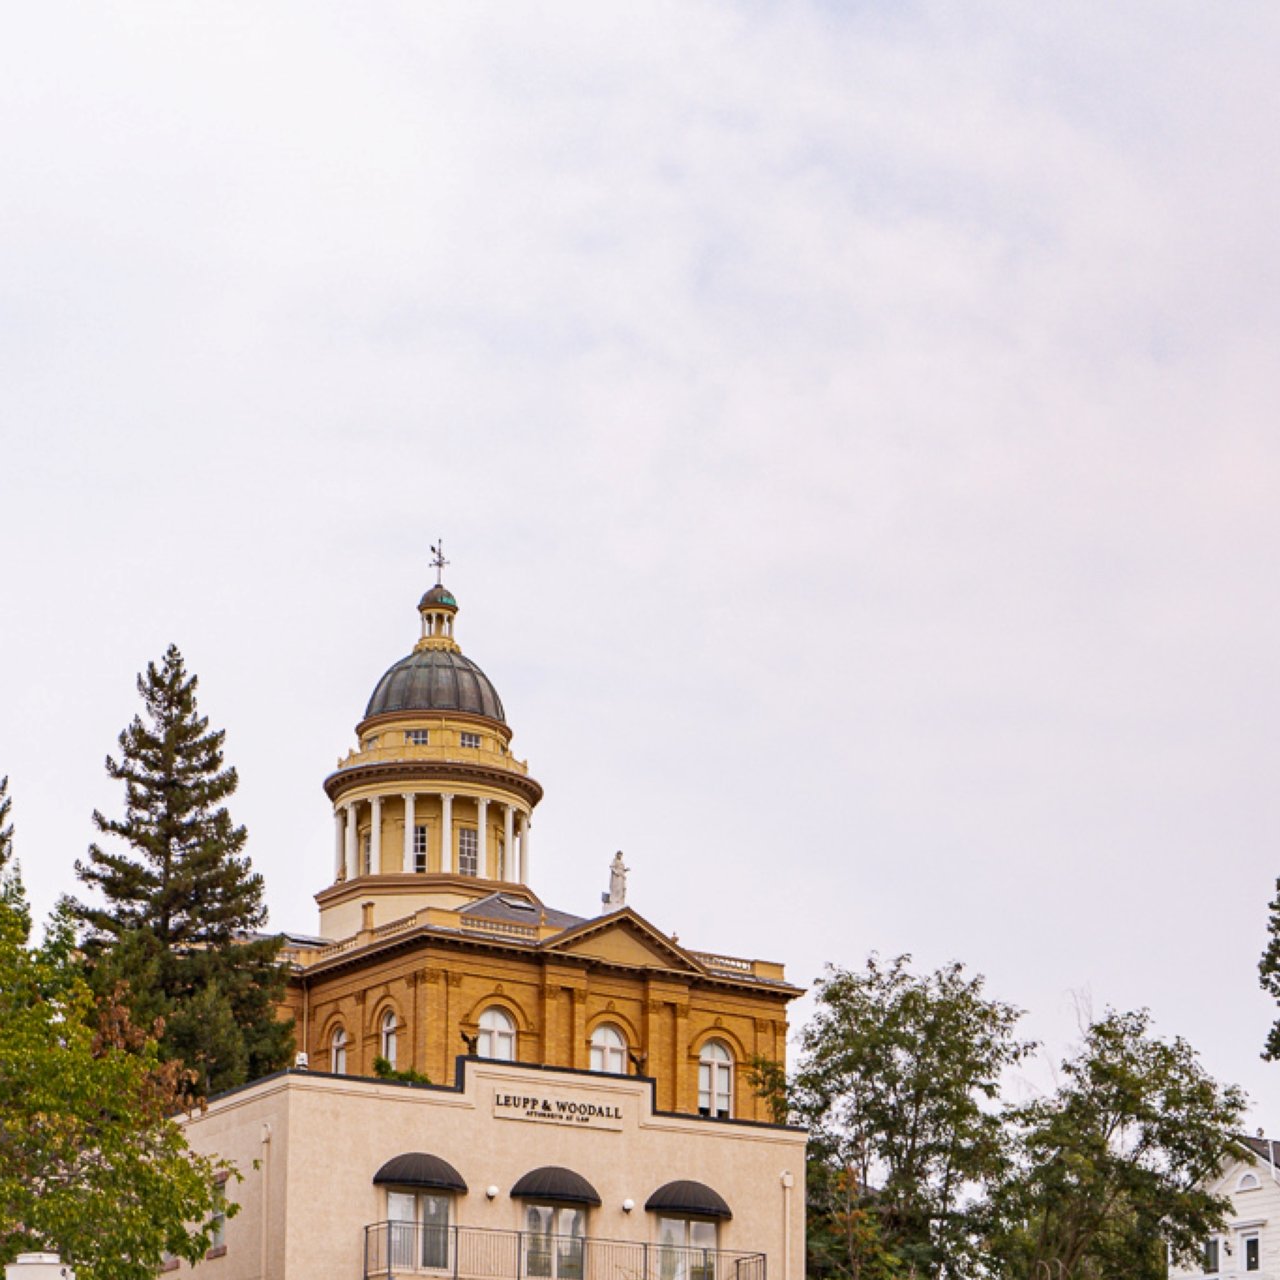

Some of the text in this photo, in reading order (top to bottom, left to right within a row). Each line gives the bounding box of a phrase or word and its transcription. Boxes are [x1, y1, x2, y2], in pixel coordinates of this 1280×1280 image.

[496, 1094, 623, 1119] LEUPP & WOODALL
